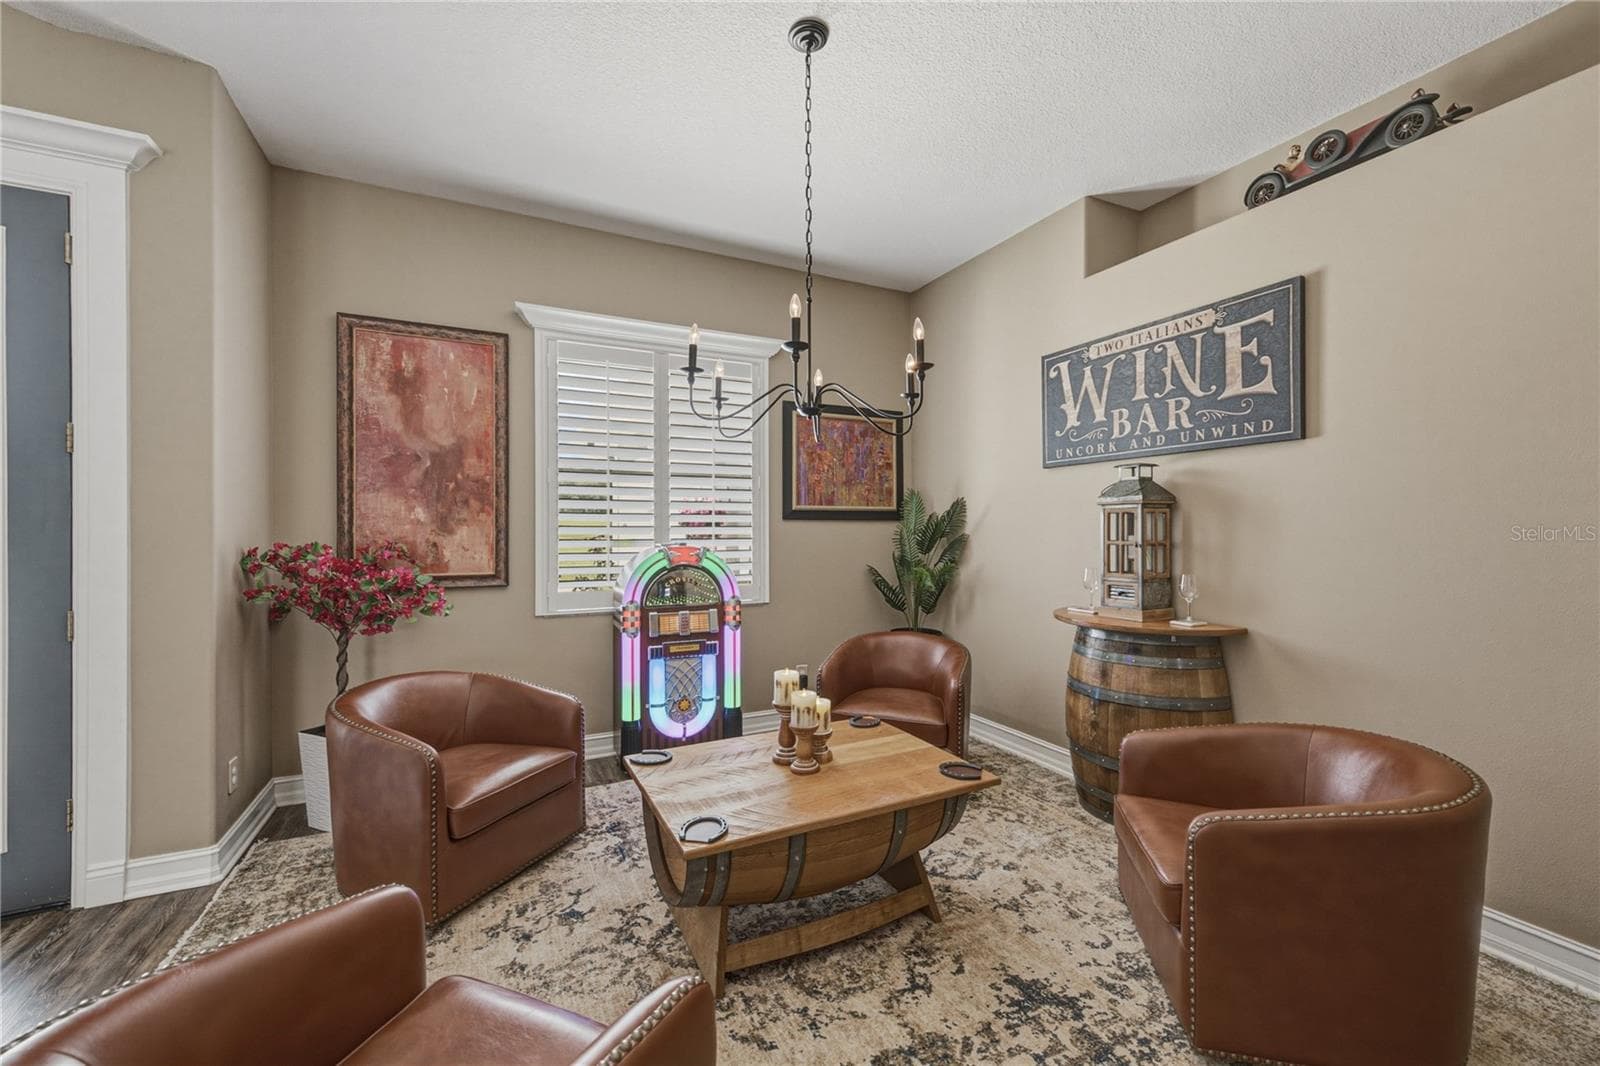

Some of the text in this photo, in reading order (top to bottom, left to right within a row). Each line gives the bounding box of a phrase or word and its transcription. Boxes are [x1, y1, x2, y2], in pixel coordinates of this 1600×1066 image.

[1095, 339, 1124, 356] TWO
[1049, 308, 1278, 437] WINE
[1055, 418, 1274, 459] UNCORK AND UNWIND
[1110, 396, 1194, 439] BAR
